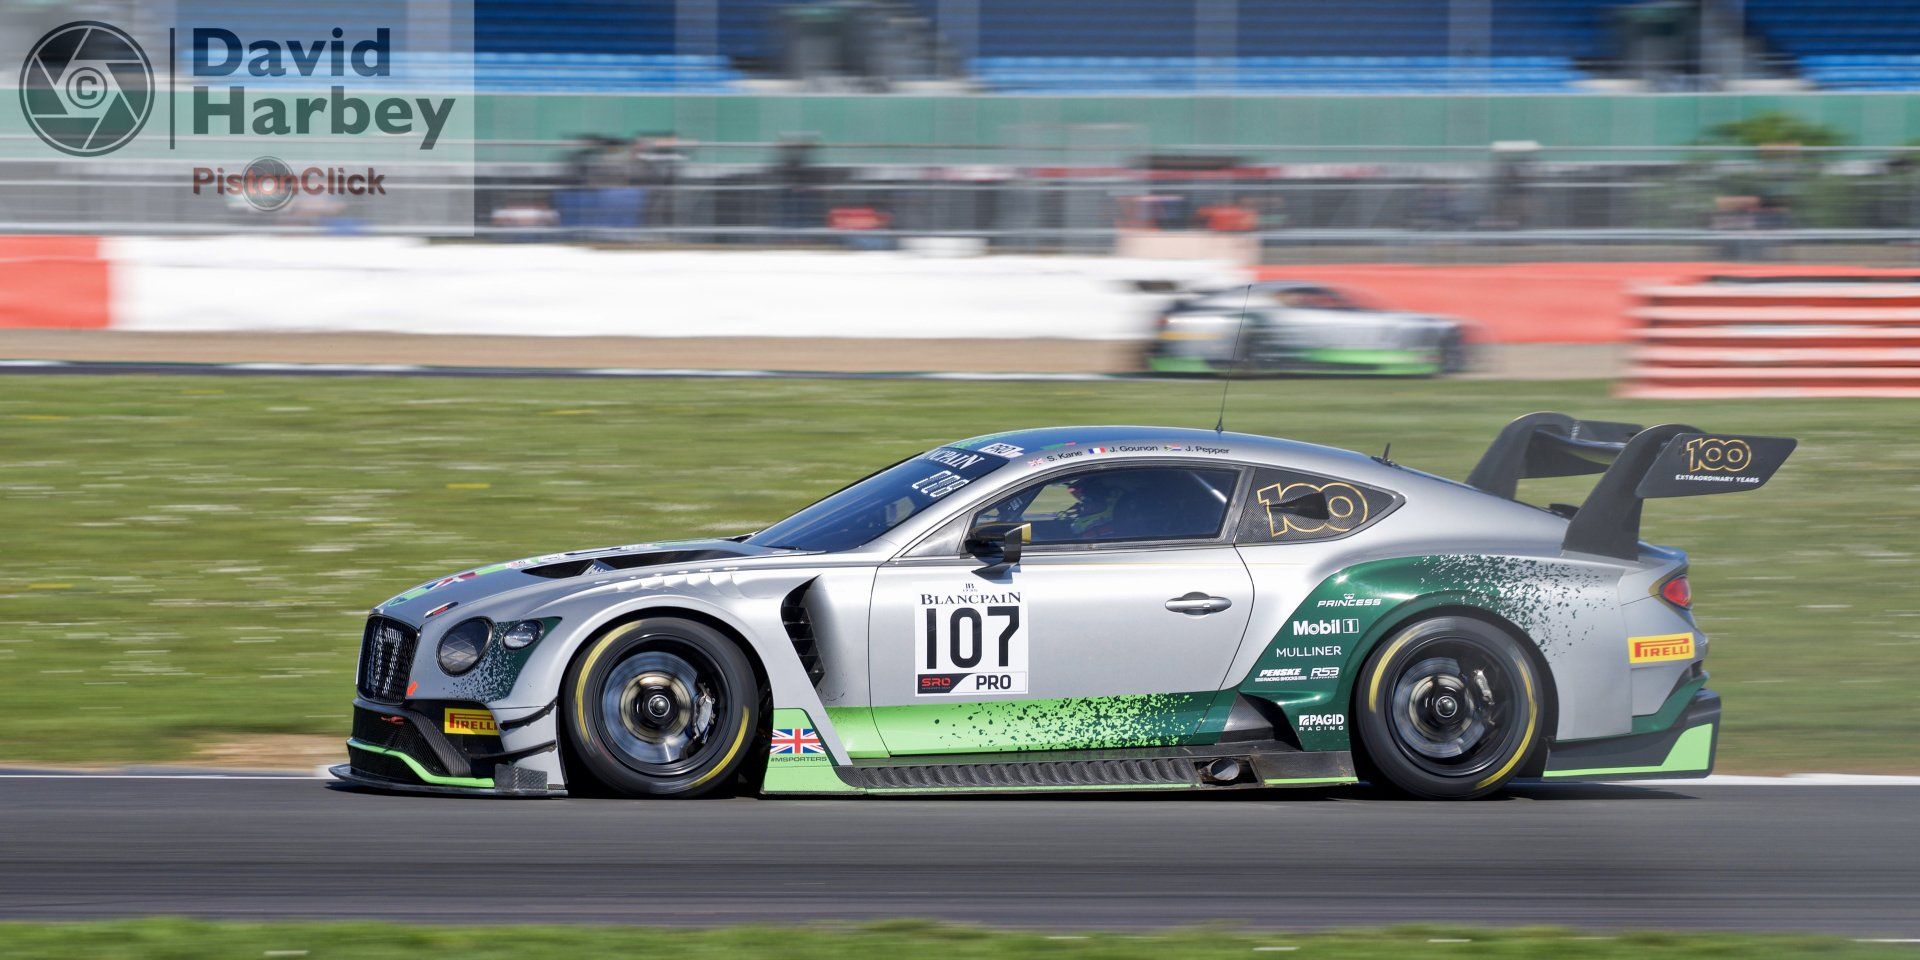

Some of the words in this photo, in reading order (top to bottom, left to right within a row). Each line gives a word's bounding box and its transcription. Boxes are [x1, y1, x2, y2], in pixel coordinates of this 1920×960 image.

[1058, 451, 1083, 459] Kane
[1686, 437, 1752, 473] 100
[1675, 474, 1734, 482] EXTRAORDINARY
[1317, 599, 1382, 608] PRINCESS
[1293, 619, 1341, 636] Mobil
[1345, 619, 1357, 633] 1
[926, 606, 1019, 669] 107
[1276, 645, 1342, 657] MULLINER
[1634, 638, 1691, 658] PIRELLI
[1259, 668, 1302, 677] PENSKE
[921, 677, 951, 687] SRO
[976, 675, 1012, 690] PRO
[1309, 714, 1345, 726] PAGID
